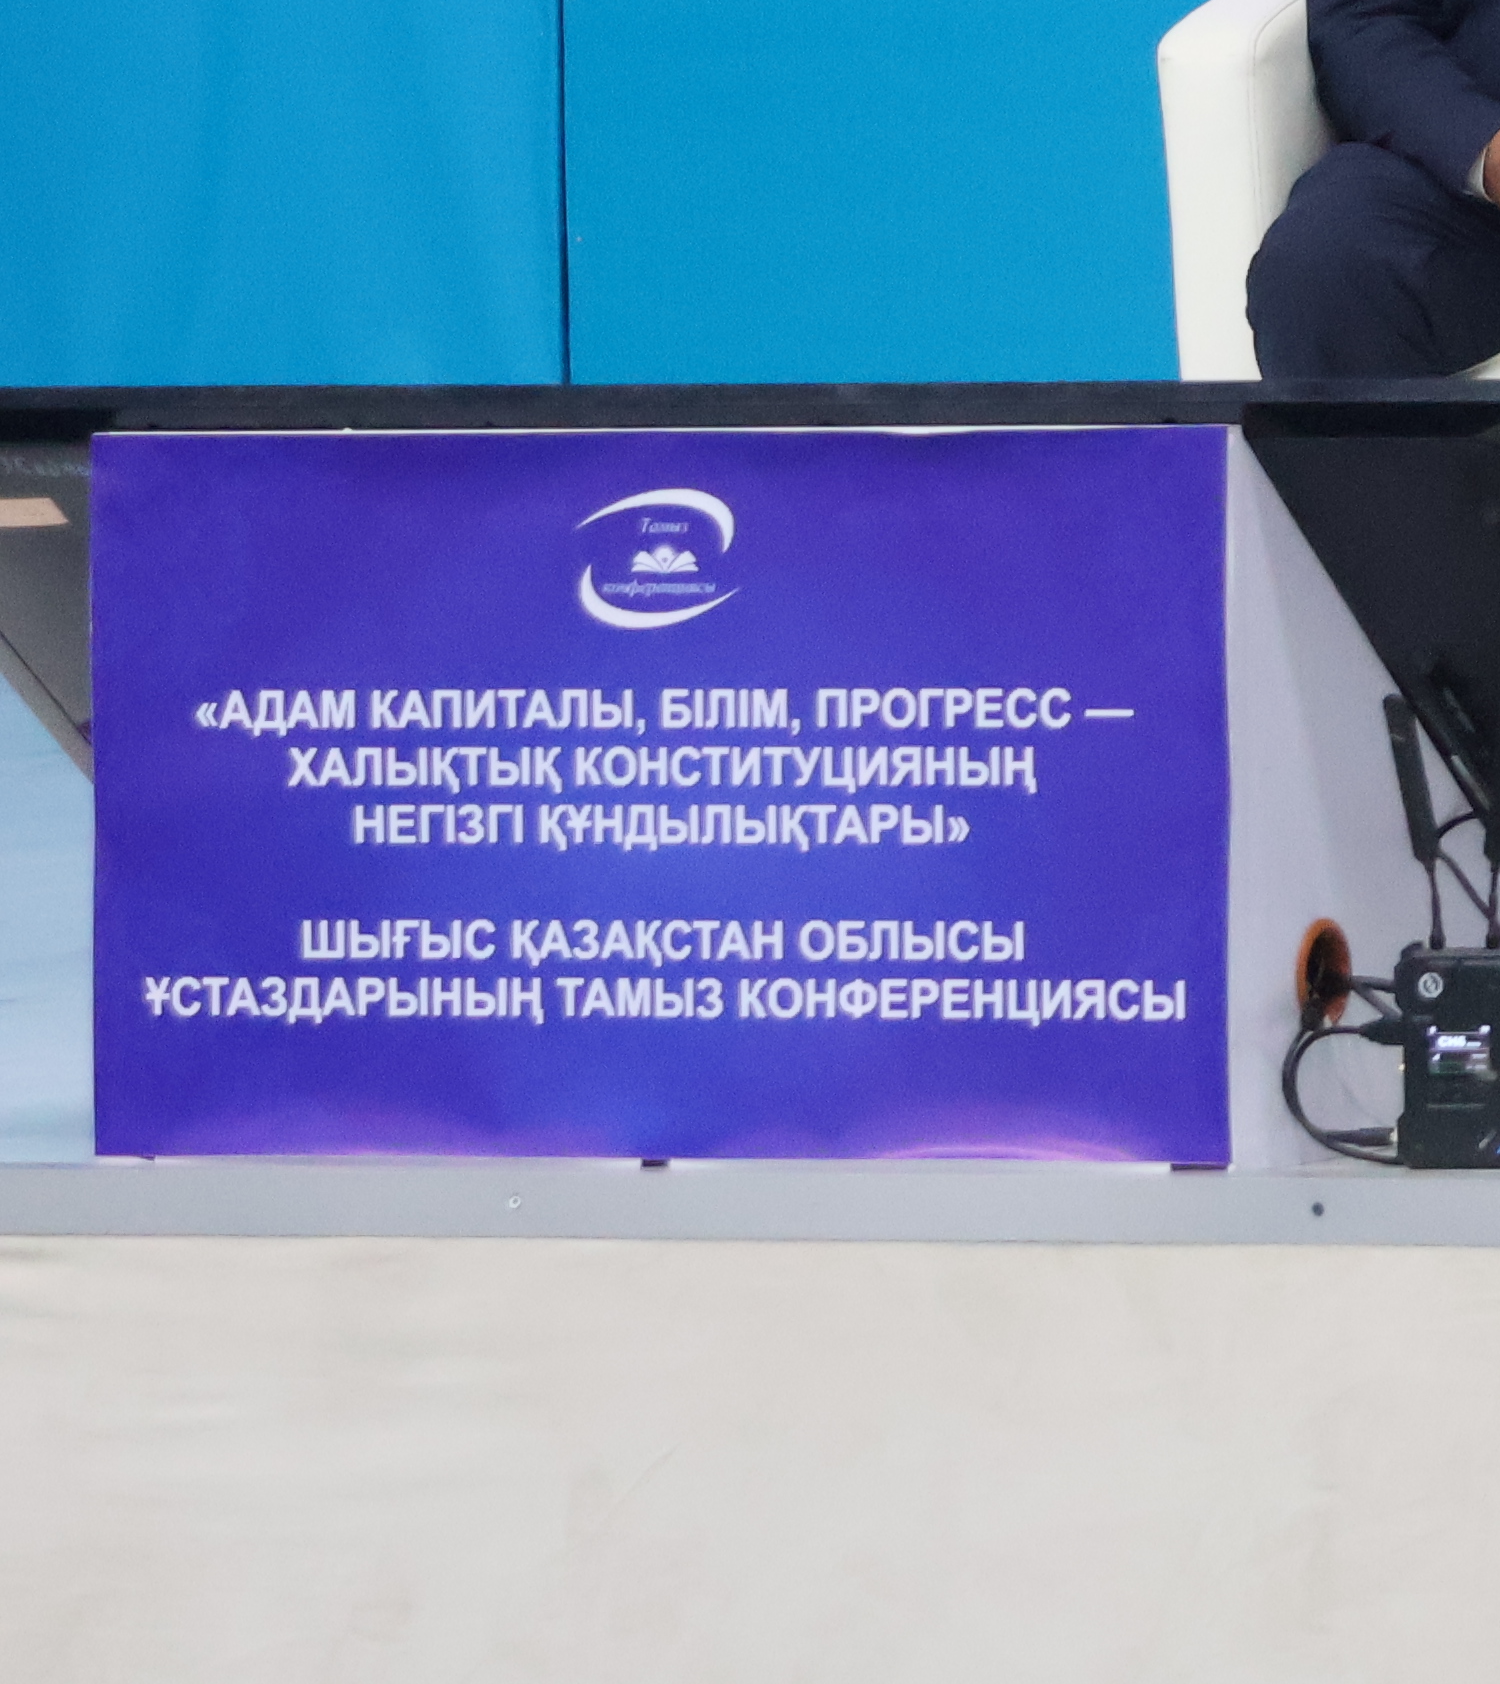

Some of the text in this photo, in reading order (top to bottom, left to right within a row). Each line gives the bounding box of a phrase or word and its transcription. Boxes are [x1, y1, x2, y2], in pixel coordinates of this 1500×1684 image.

[194, 689, 356, 738] «АДАМ
[369, 688, 646, 737] КАПИТАЛЫ,
[658, 688, 801, 737] БІЛІМ,
[815, 687, 1072, 731] ПРОГРЕСС
[287, 745, 1038, 796] ХАЛЫҚТЫҚ КОНСТИТУЦИЯНЫҢ
[352, 803, 970, 854] НЕГІЗГІ ҚҰНДЫЛЫҚТАРЫ»
[300, 918, 1025, 968] ШЫҒЫС ҚАЗАҚСТАН ОБЛЫСЫ
[144, 976, 1188, 1027] ҰСТАЗДАРЫНЫҢ ТАМЫЗ КОНФЕРЕНЦИЯСЫ
